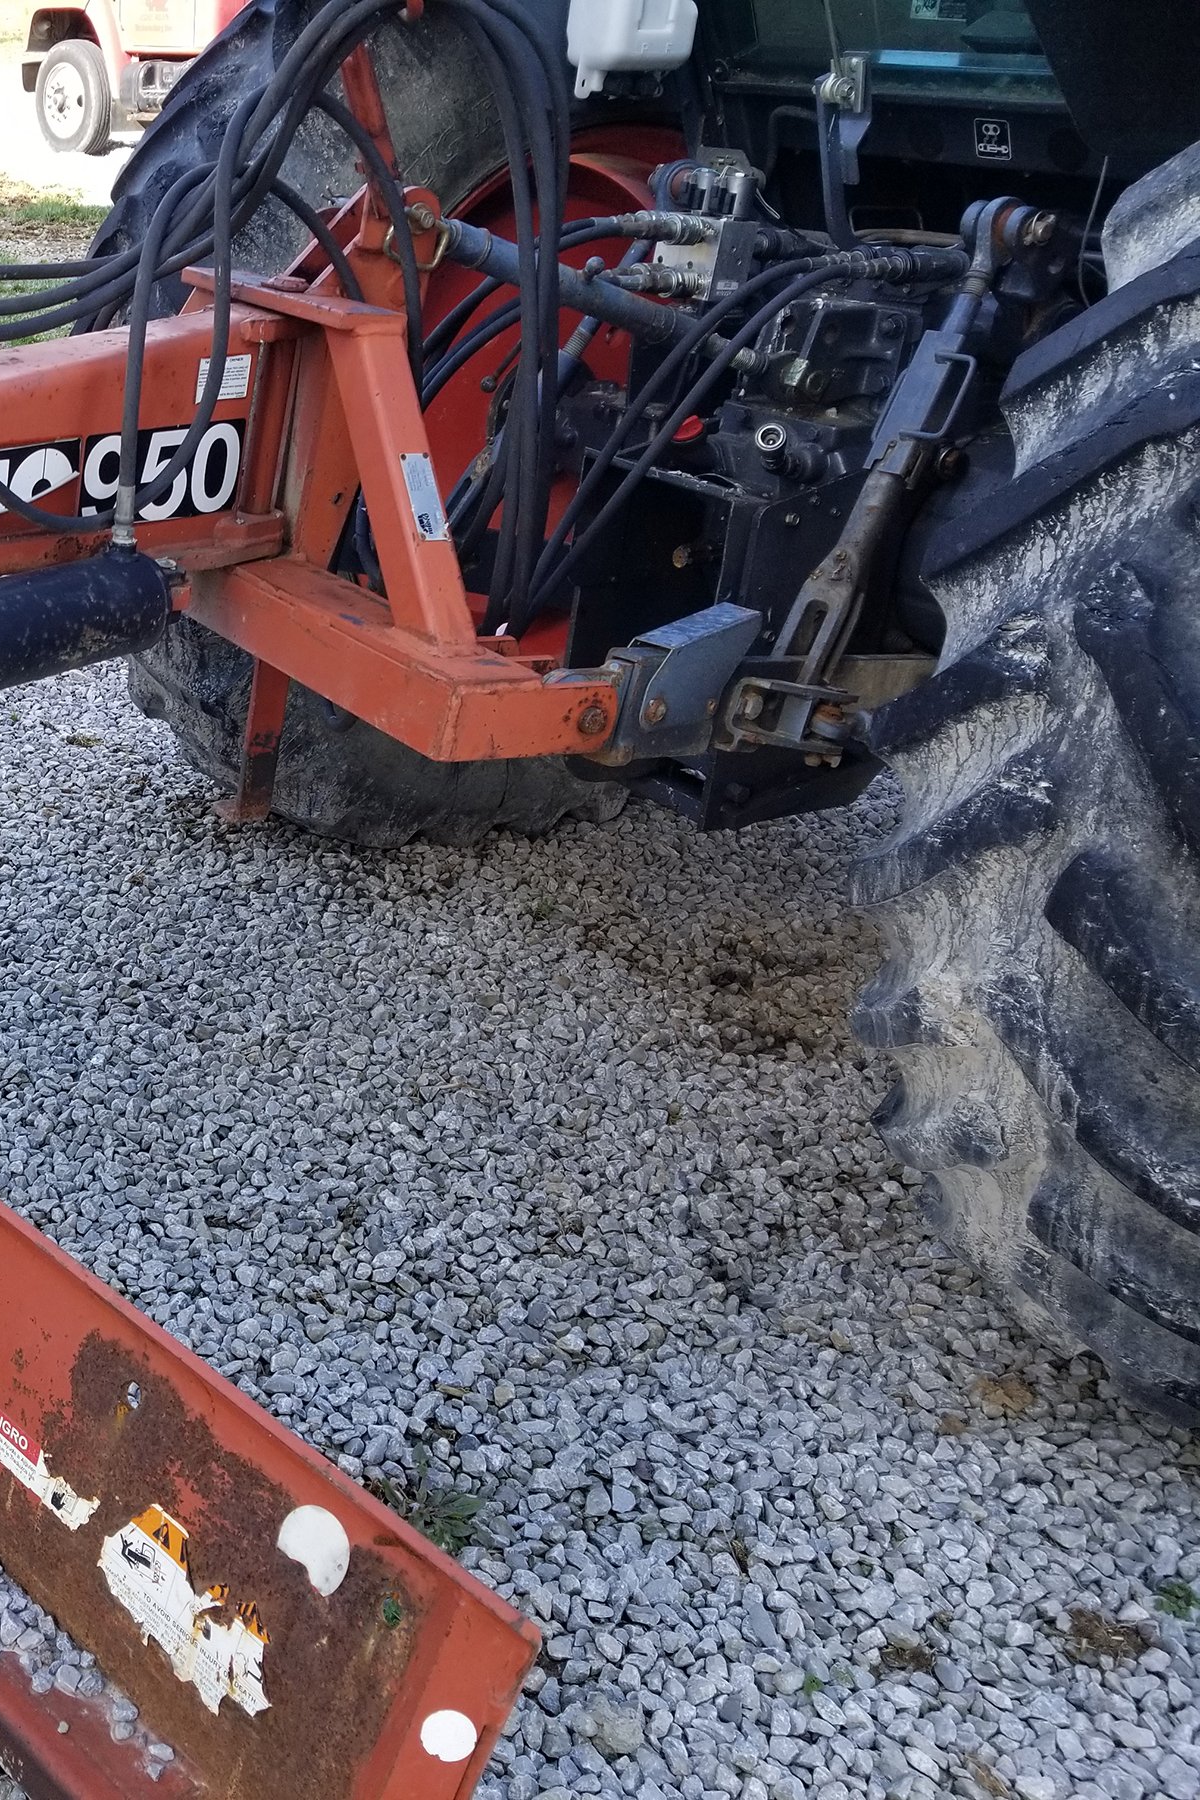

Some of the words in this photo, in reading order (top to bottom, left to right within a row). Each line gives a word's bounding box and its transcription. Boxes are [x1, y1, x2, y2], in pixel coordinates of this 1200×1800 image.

[83, 421, 240, 521] 950
[143, 1592, 151, 1603] TO
[153, 1602, 171, 1622] AVOID
[171, 1620, 198, 1648] SERIOUS
[199, 1647, 221, 1670] INJURY
[234, 1680, 256, 1704] DEATH
